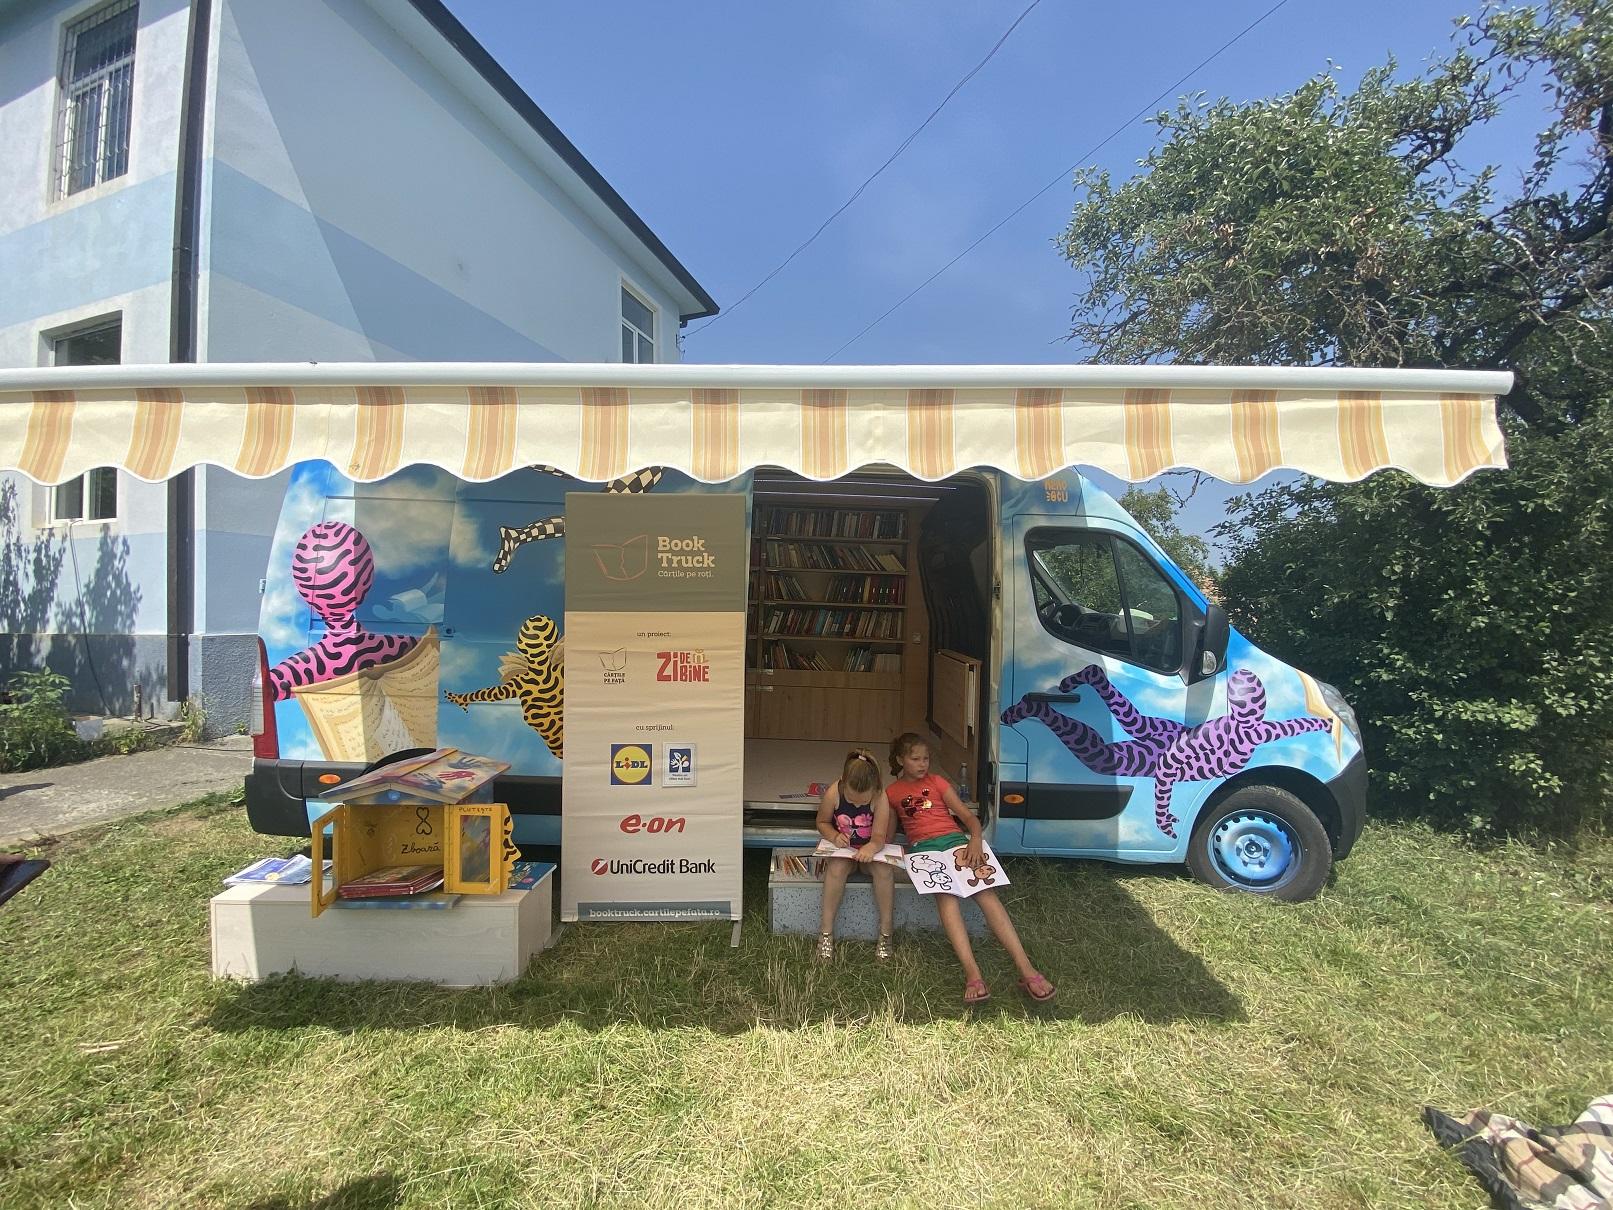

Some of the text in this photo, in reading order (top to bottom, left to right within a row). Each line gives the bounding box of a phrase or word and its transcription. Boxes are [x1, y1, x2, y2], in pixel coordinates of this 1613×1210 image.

[657, 536, 705, 551] Book
[657, 552, 715, 568] Truck
[686, 571, 696, 579] pe
[680, 652, 691, 664] DE
[401, 841, 440, 855] Zboară
[609, 858, 716, 875] UniCredit Bank
[588, 907, 721, 918] booktruck.cartilepefata.ro
